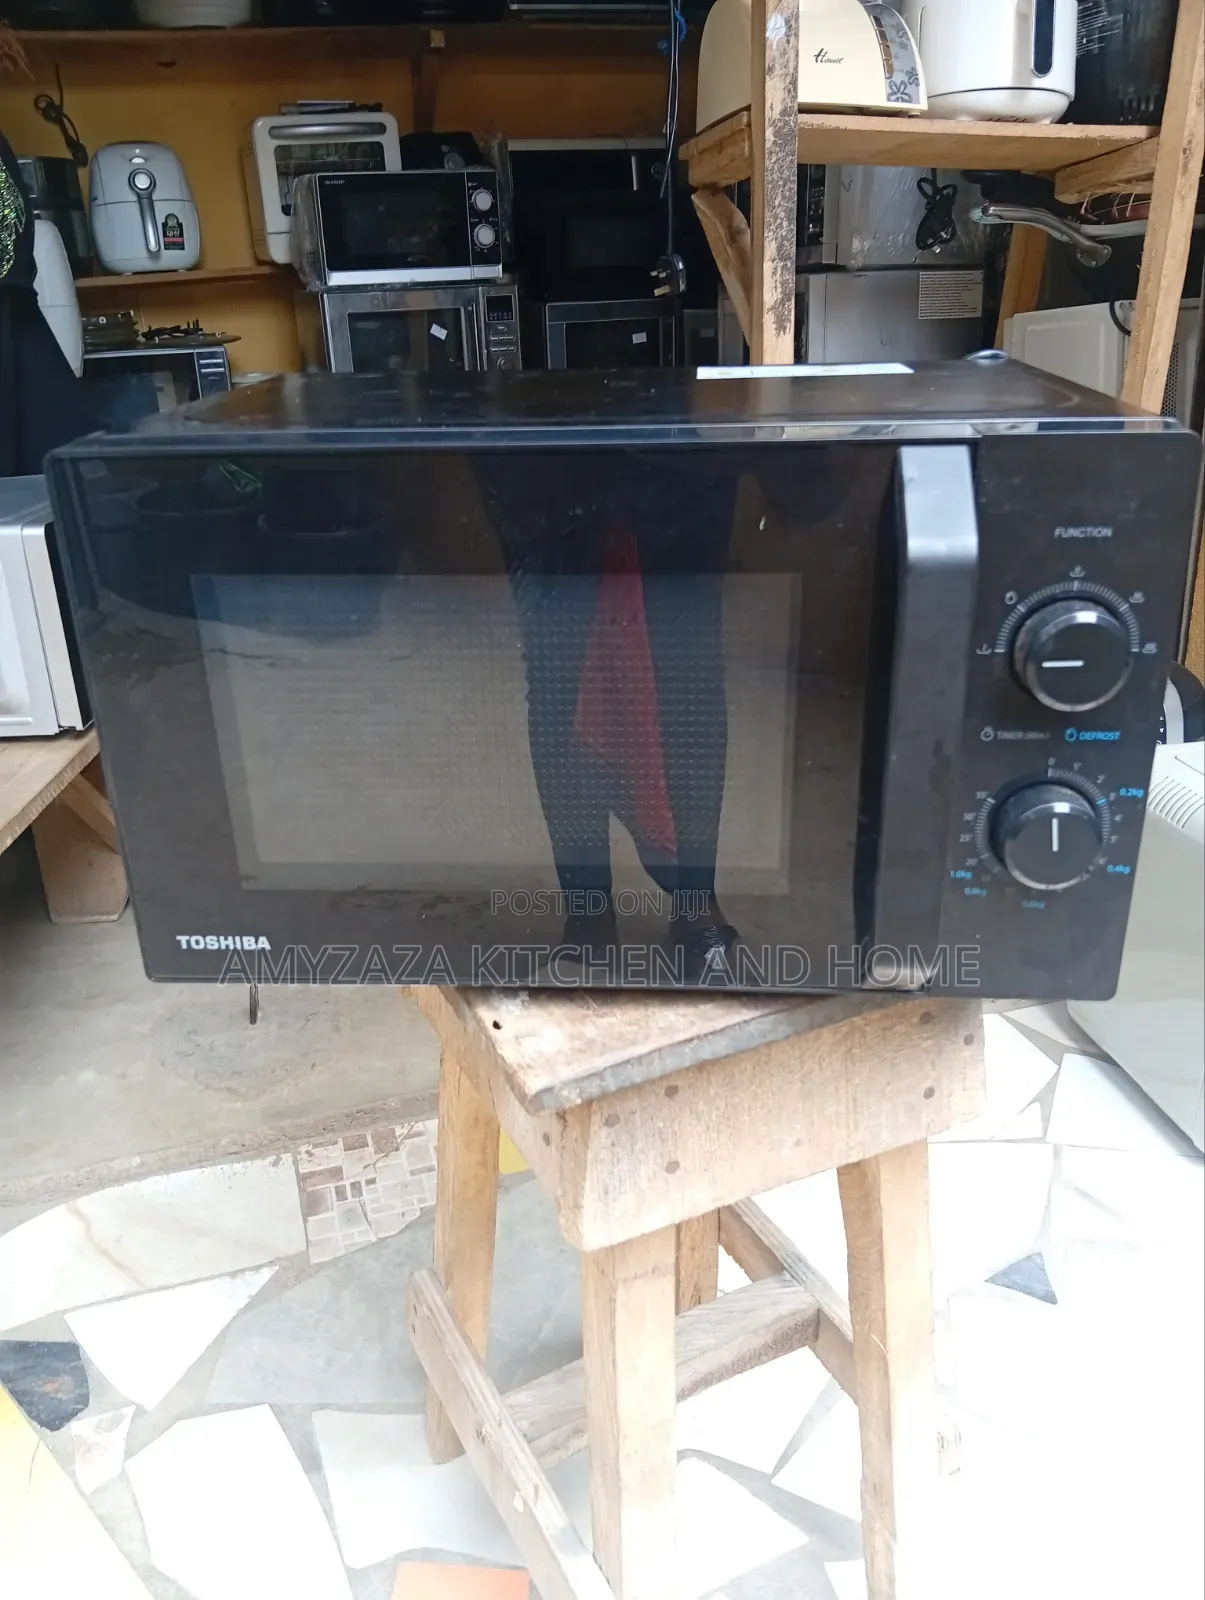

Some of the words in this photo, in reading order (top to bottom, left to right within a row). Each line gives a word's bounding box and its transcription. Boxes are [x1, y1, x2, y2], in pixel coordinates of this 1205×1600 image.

[1054, 526, 1113, 538] FUNCTION
[996, 731, 1023, 741] TIMER
[1078, 730, 1121, 741] DEFROST
[1119, 787, 1144, 798] 0.2kg
[176, 935, 271, 951] TOSHIBA
